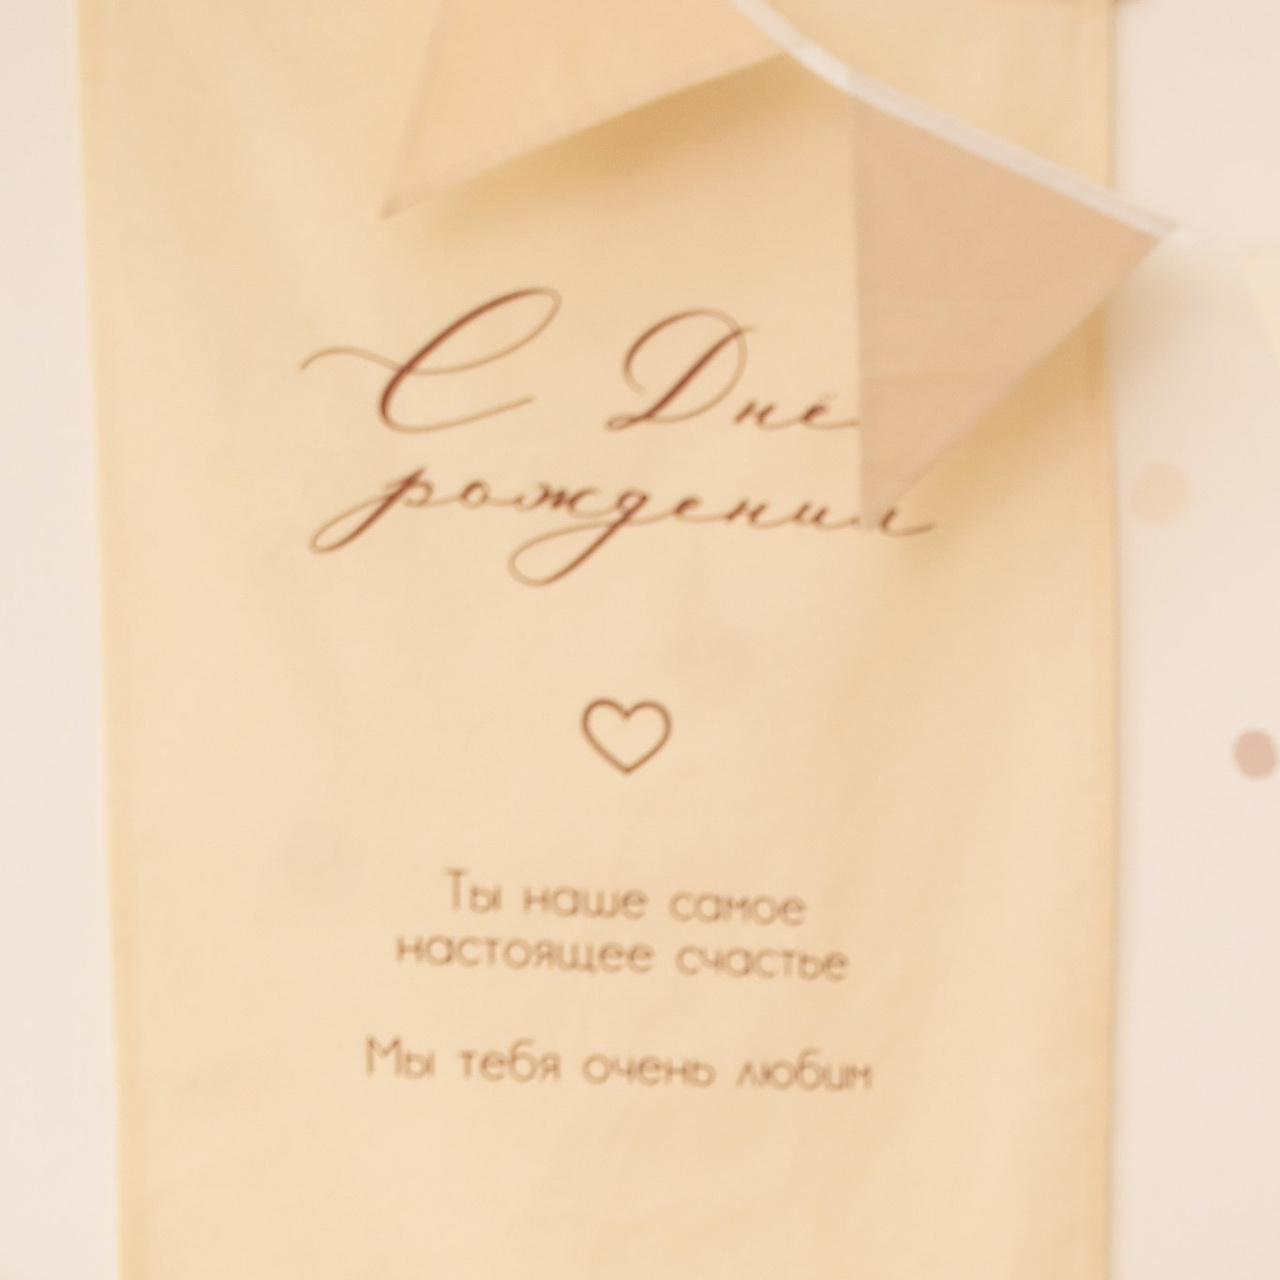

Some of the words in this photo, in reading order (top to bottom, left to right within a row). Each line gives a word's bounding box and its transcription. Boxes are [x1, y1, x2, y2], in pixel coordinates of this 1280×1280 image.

[298, 286, 562, 434] С
[603, 308, 859, 433] Днё
[443, 866, 503, 914] Ты
[522, 886, 650, 921] наше
[668, 890, 808, 927] самое
[395, 934, 655, 975] настоящее
[674, 944, 850, 983] счастье
[364, 1034, 436, 1081] Мы
[457, 1037, 562, 1084] тебя
[581, 1053, 717, 1089] очень
[735, 1047, 874, 1092] любим
